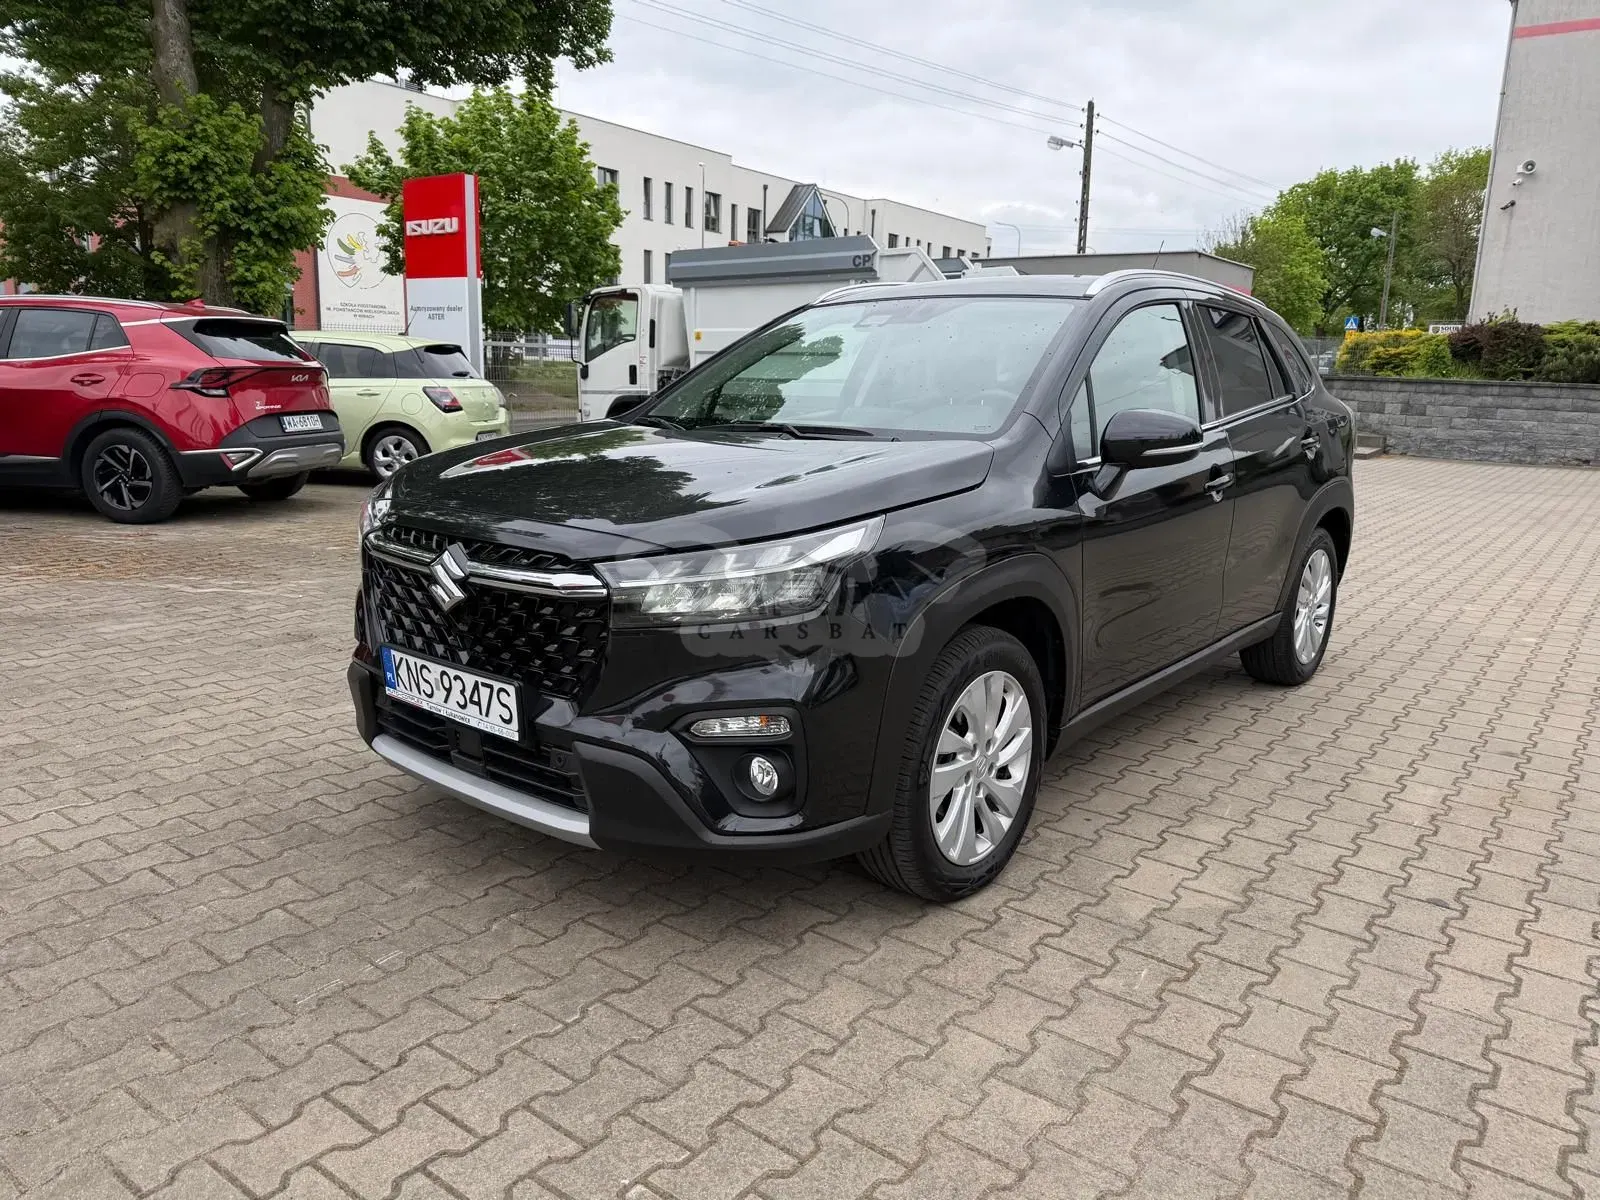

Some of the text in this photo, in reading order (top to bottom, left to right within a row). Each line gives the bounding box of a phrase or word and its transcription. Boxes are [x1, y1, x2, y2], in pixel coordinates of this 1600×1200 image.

[406, 217, 459, 236] ISUZU
[852, 254, 871, 267] CP
[386, 671, 395, 683] PL
[393, 655, 513, 724] KNS 9347S
